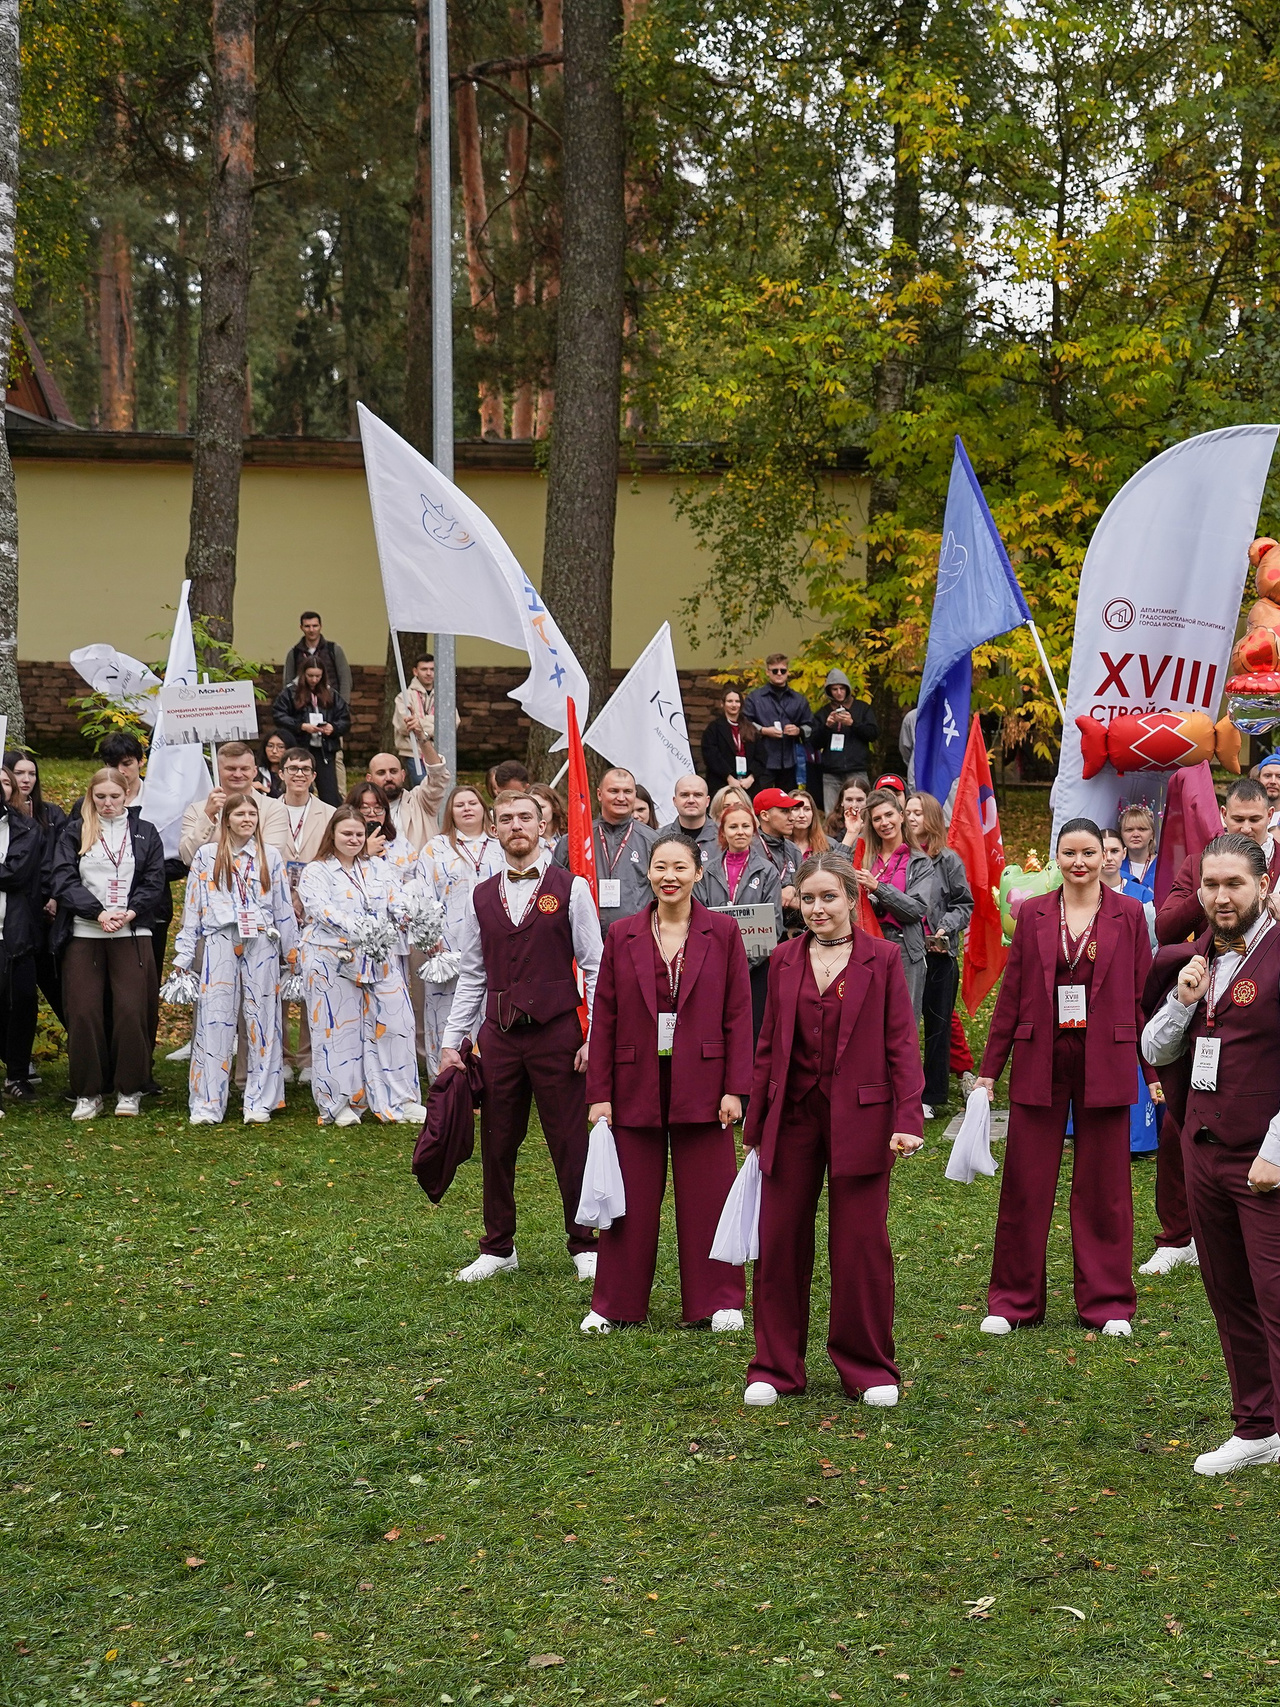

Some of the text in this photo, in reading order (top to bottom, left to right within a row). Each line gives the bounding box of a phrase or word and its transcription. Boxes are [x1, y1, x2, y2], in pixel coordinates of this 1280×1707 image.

[1140, 607, 1178, 615] ДЕПАРТАМЕНТ
[1139, 613, 1226, 631] ГРАДОСТРОИТЕЛЬНОЙ ПОЛИТИКИ
[1139, 620, 1186, 629] ГОРОДА МОСКВЫ
[1093, 651, 1218, 709] XVIII
[198, 704, 251, 713] ИННОВАЦИОННЫХ
[176, 711, 214, 719] ТЕХНОЛОГИЙ
[654, 726, 692, 768] АВТОРСКИЙ
[751, 908, 755, 916] 1
